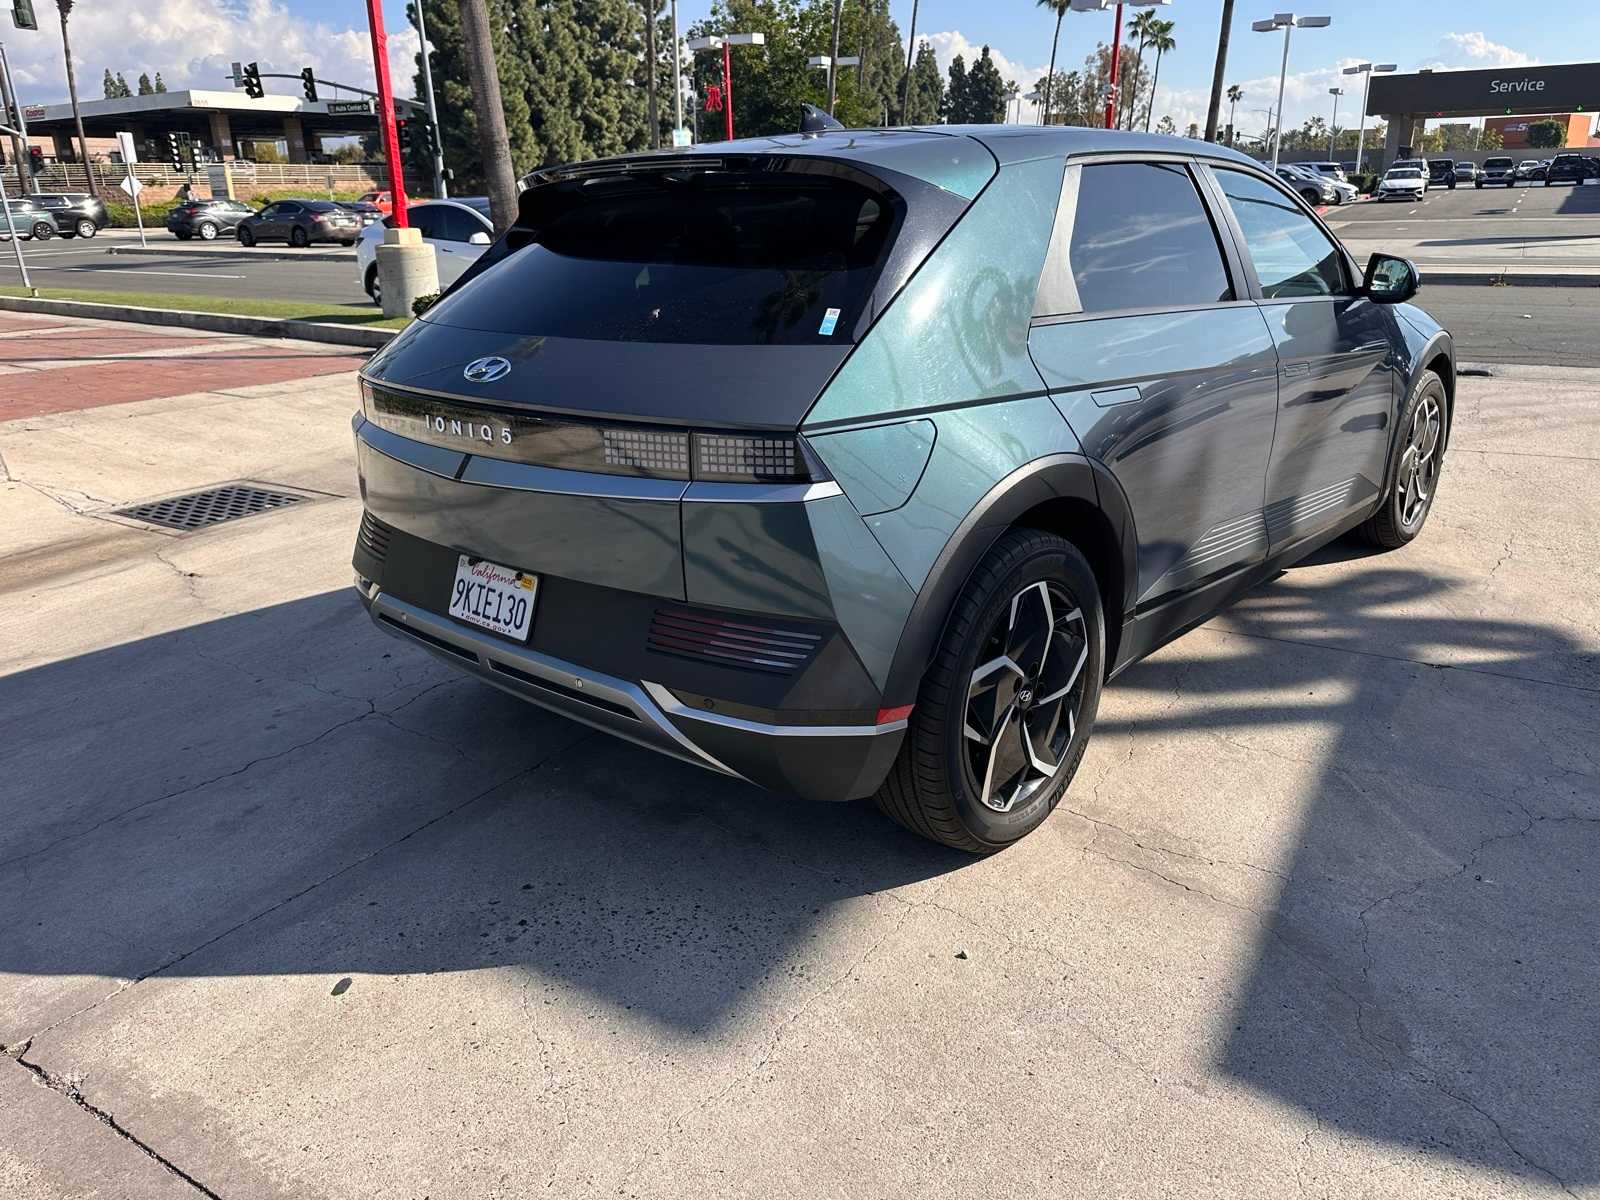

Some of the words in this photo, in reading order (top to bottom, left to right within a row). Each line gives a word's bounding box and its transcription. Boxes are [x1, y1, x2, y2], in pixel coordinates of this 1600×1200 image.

[1489, 78, 1545, 93] Service
[425, 414, 493, 441] IONIQ
[501, 428, 512, 445] 5
[471, 563, 517, 585] California
[452, 578, 527, 630] 9KIE130
